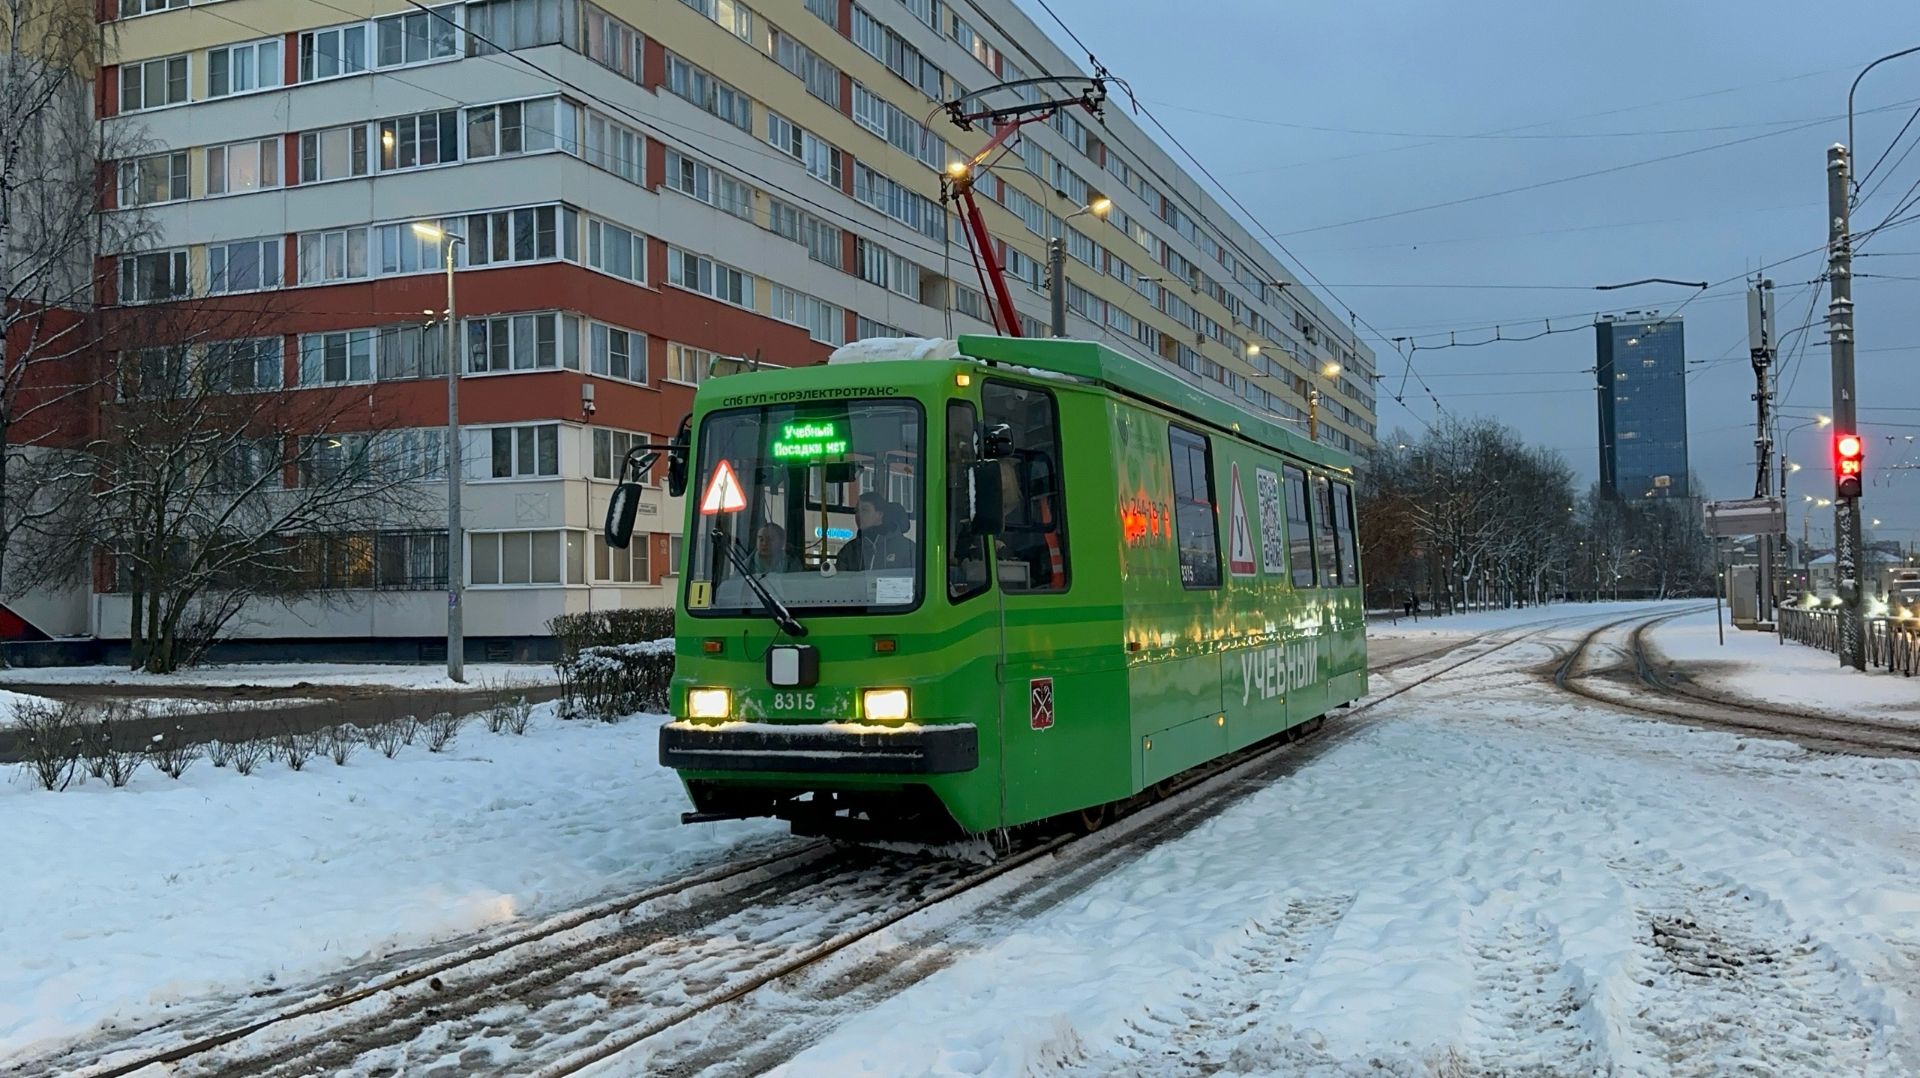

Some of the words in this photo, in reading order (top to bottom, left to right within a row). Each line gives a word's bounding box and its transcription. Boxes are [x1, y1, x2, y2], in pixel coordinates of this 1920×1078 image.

[745, 394, 767, 405] ГУП
[769, 386, 899, 402] «ГОРЭЛЕКТРОТРАНС»
[784, 423, 834, 440] Учебный
[774, 442, 822, 457] Посадки
[826, 441, 846, 454] нет
[1842, 460, 1860, 474] 54
[774, 692, 815, 711] 8315
